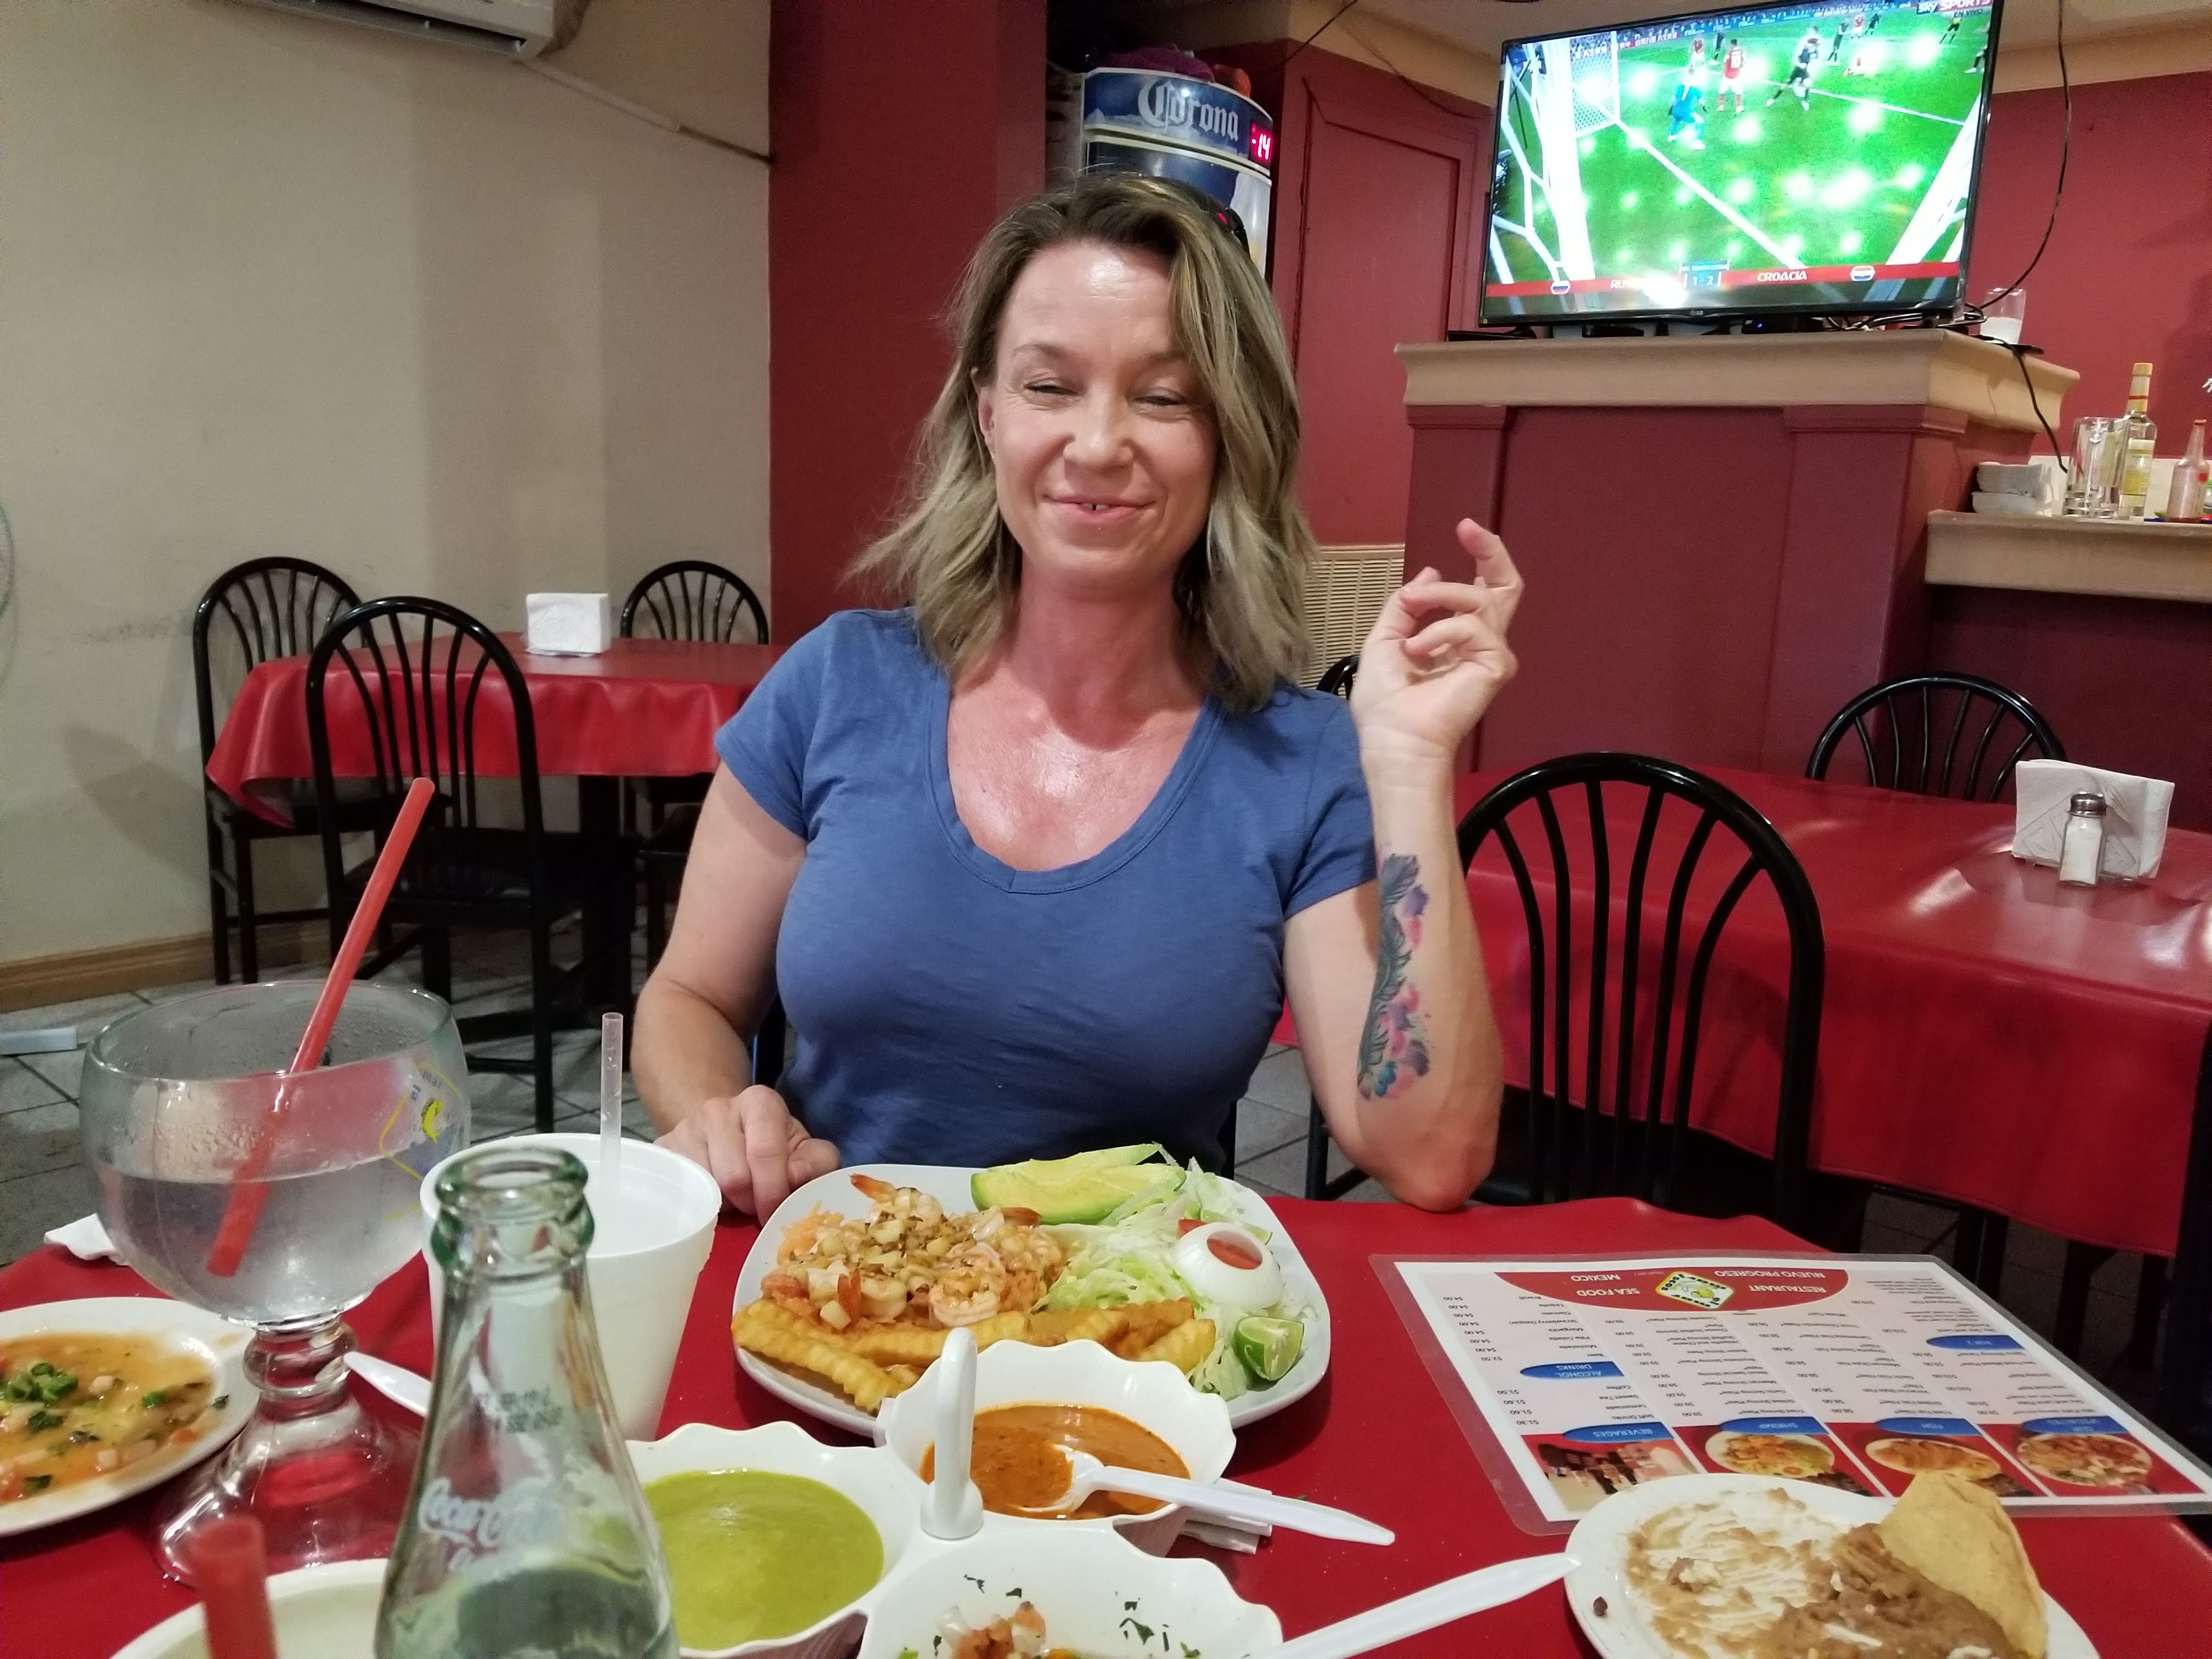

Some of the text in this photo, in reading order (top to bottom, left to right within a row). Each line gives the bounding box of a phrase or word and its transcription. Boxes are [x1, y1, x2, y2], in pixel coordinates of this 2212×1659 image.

[1917, 1, 1938, 13] sky
[1137, 78, 1239, 143] Corona
[1251, 133, 1272, 160] -14
[1706, 275, 1714, 285] 2
[1757, 270, 1808, 282] CROACIA
[1570, 1273, 1621, 1282] MEXICO
[1713, 1269, 1780, 1278] PROGRESO
[1576, 1288, 1612, 1297] FOOD
[1748, 1284, 1827, 1294] RESTAURANT
[1593, 1428, 1652, 1438] BEVERAGES
